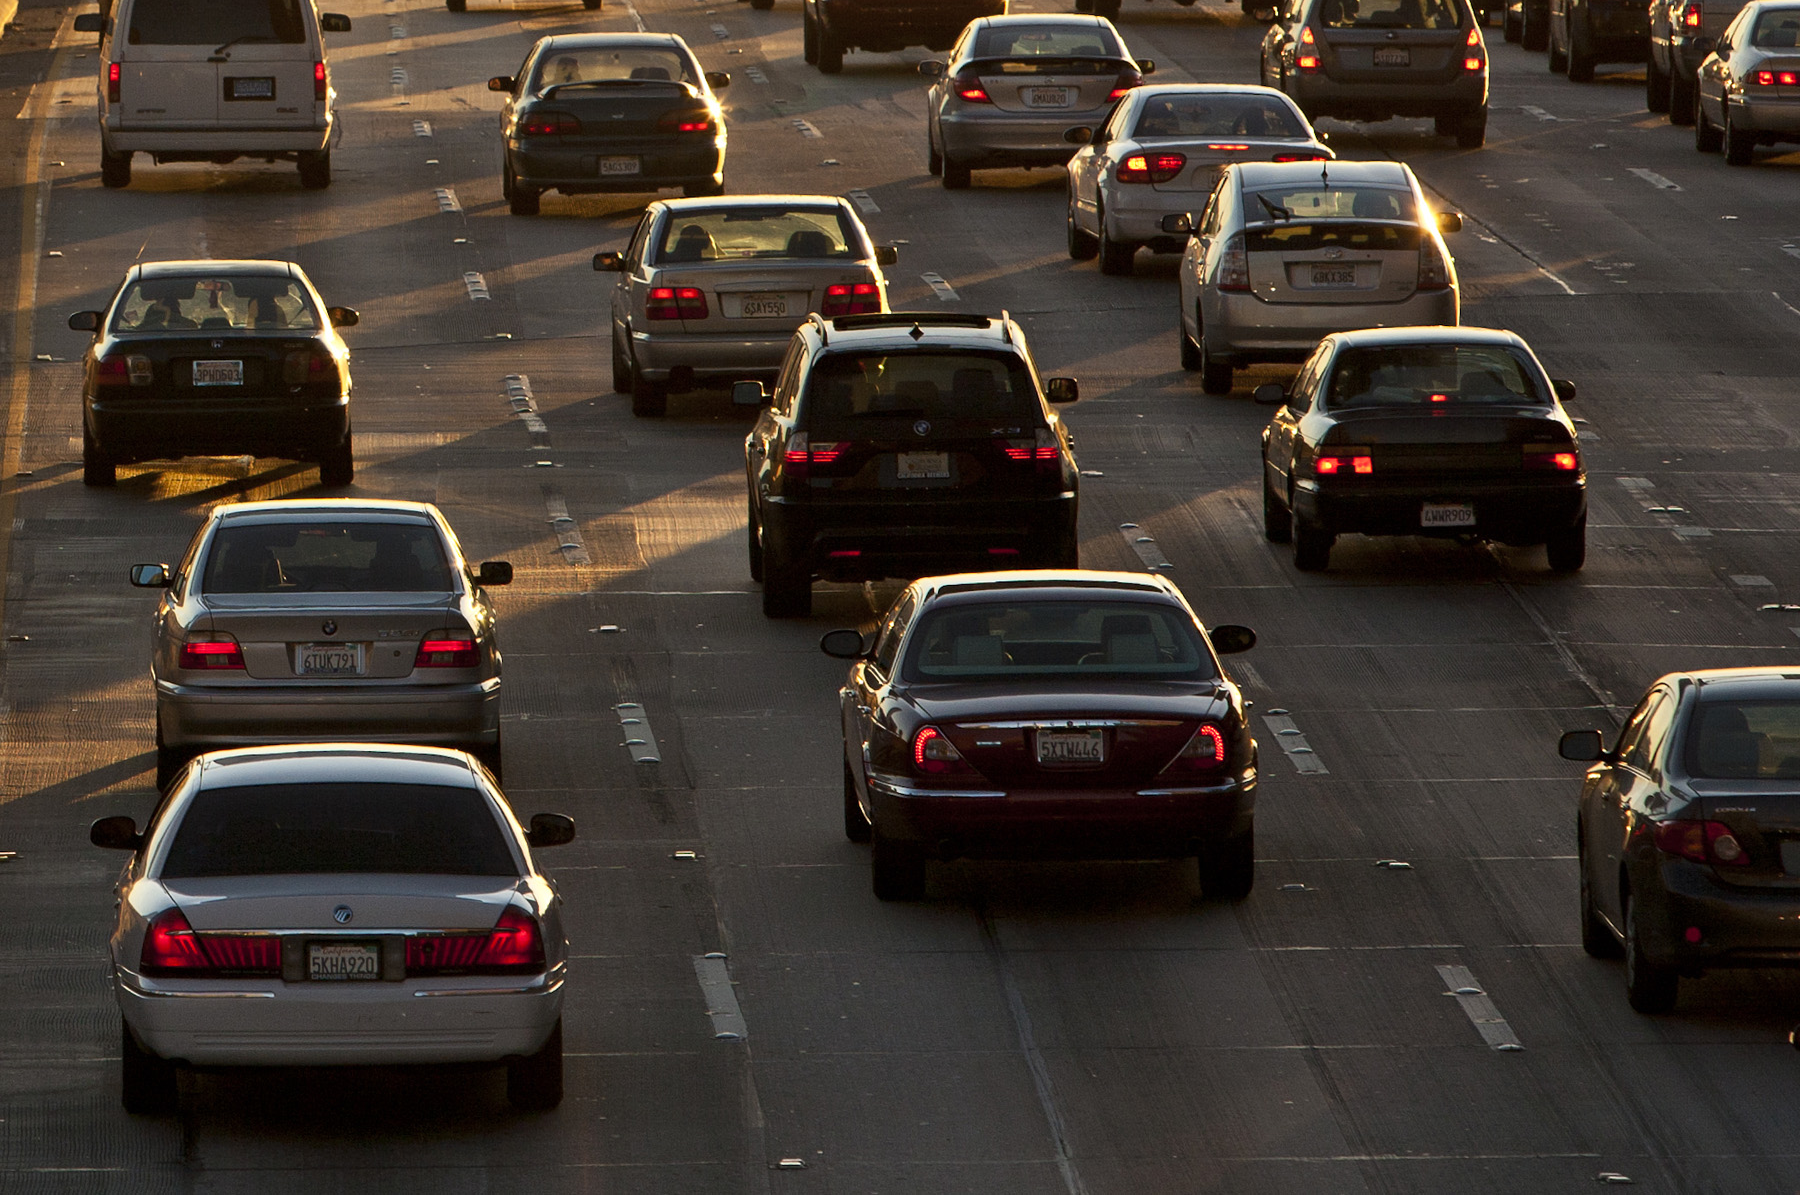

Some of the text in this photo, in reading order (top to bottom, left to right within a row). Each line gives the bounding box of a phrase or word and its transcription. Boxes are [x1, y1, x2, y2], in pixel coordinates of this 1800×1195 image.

[744, 302, 786, 315] 6SAY550
[304, 653, 356, 669] 6TUK791
[322, 946, 366, 956] California
[311, 956, 375, 974] 5KHA920
